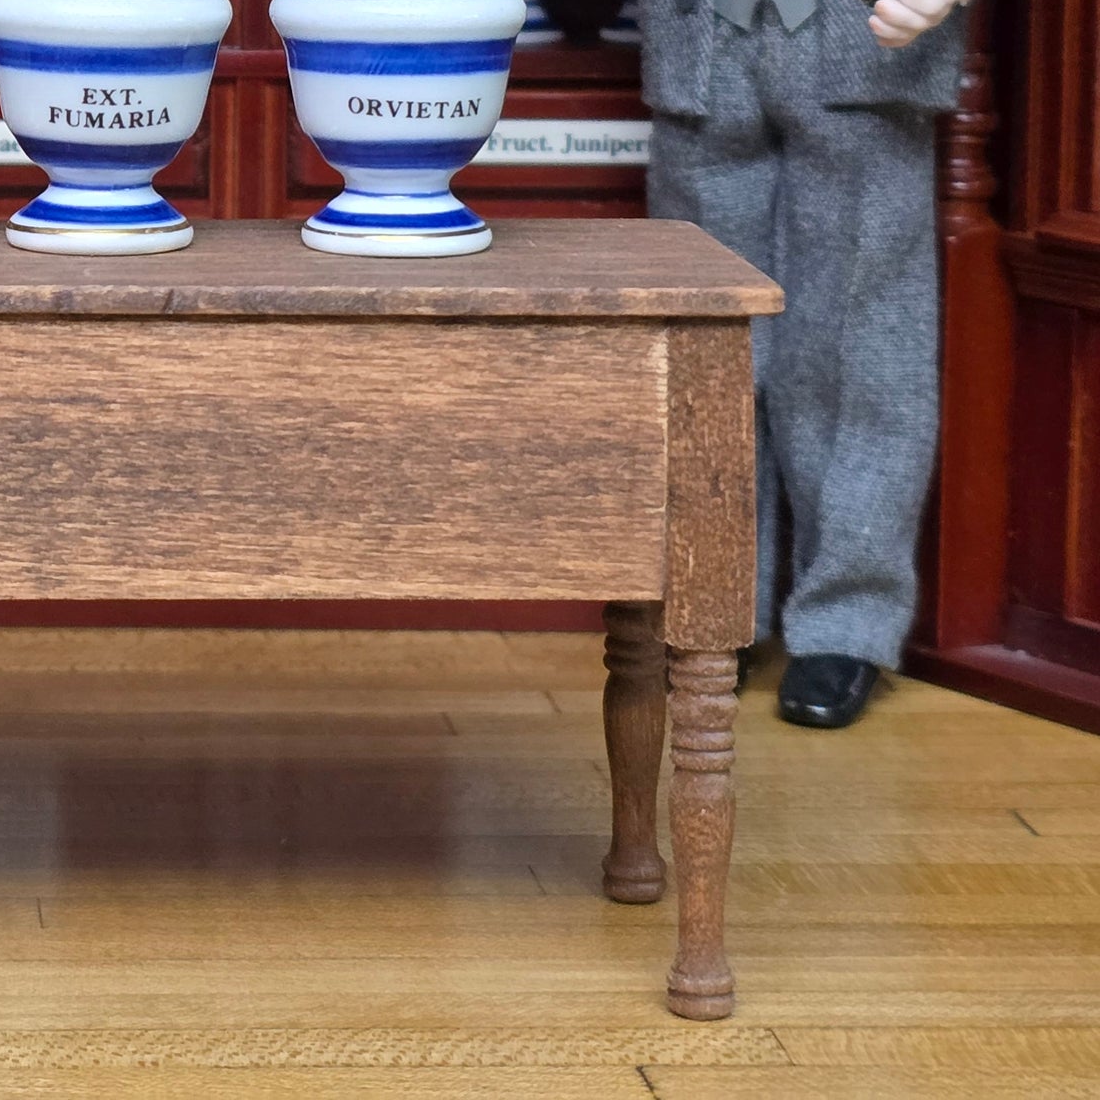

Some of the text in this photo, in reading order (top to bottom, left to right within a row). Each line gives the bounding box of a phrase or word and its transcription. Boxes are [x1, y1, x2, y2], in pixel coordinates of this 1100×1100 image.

[81, 87, 143, 107] EXT.
[347, 95, 483, 120] ORVIETAN
[48, 105, 172, 130] FUMARIA
[486, 133, 551, 152] Fruct.
